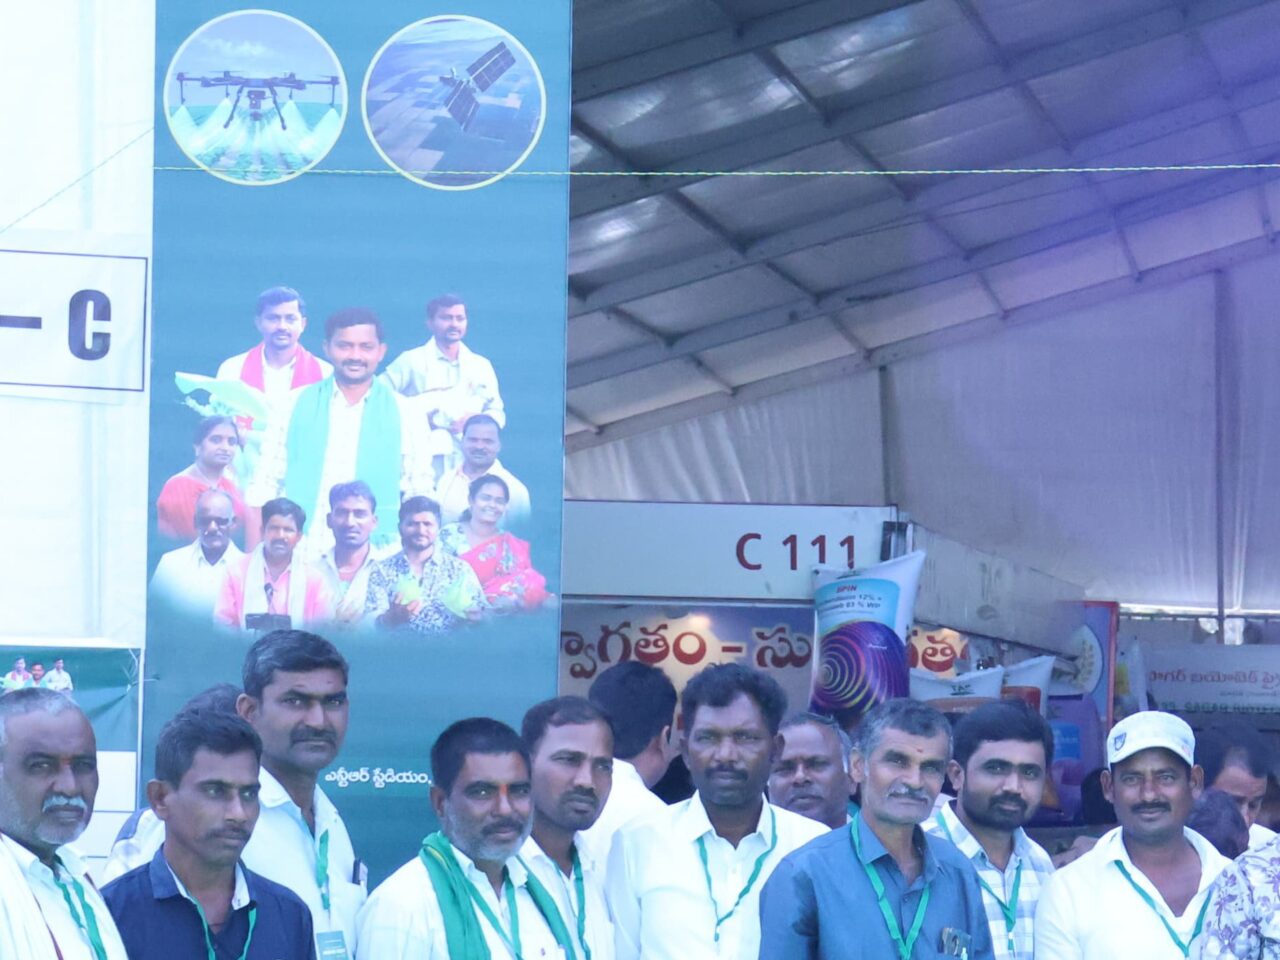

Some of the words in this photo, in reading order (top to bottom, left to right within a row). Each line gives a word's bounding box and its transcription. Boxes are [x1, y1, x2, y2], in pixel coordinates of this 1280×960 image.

[68, 289, 111, 361] C
[736, 532, 762, 571] C
[782, 534, 855, 570] 111
